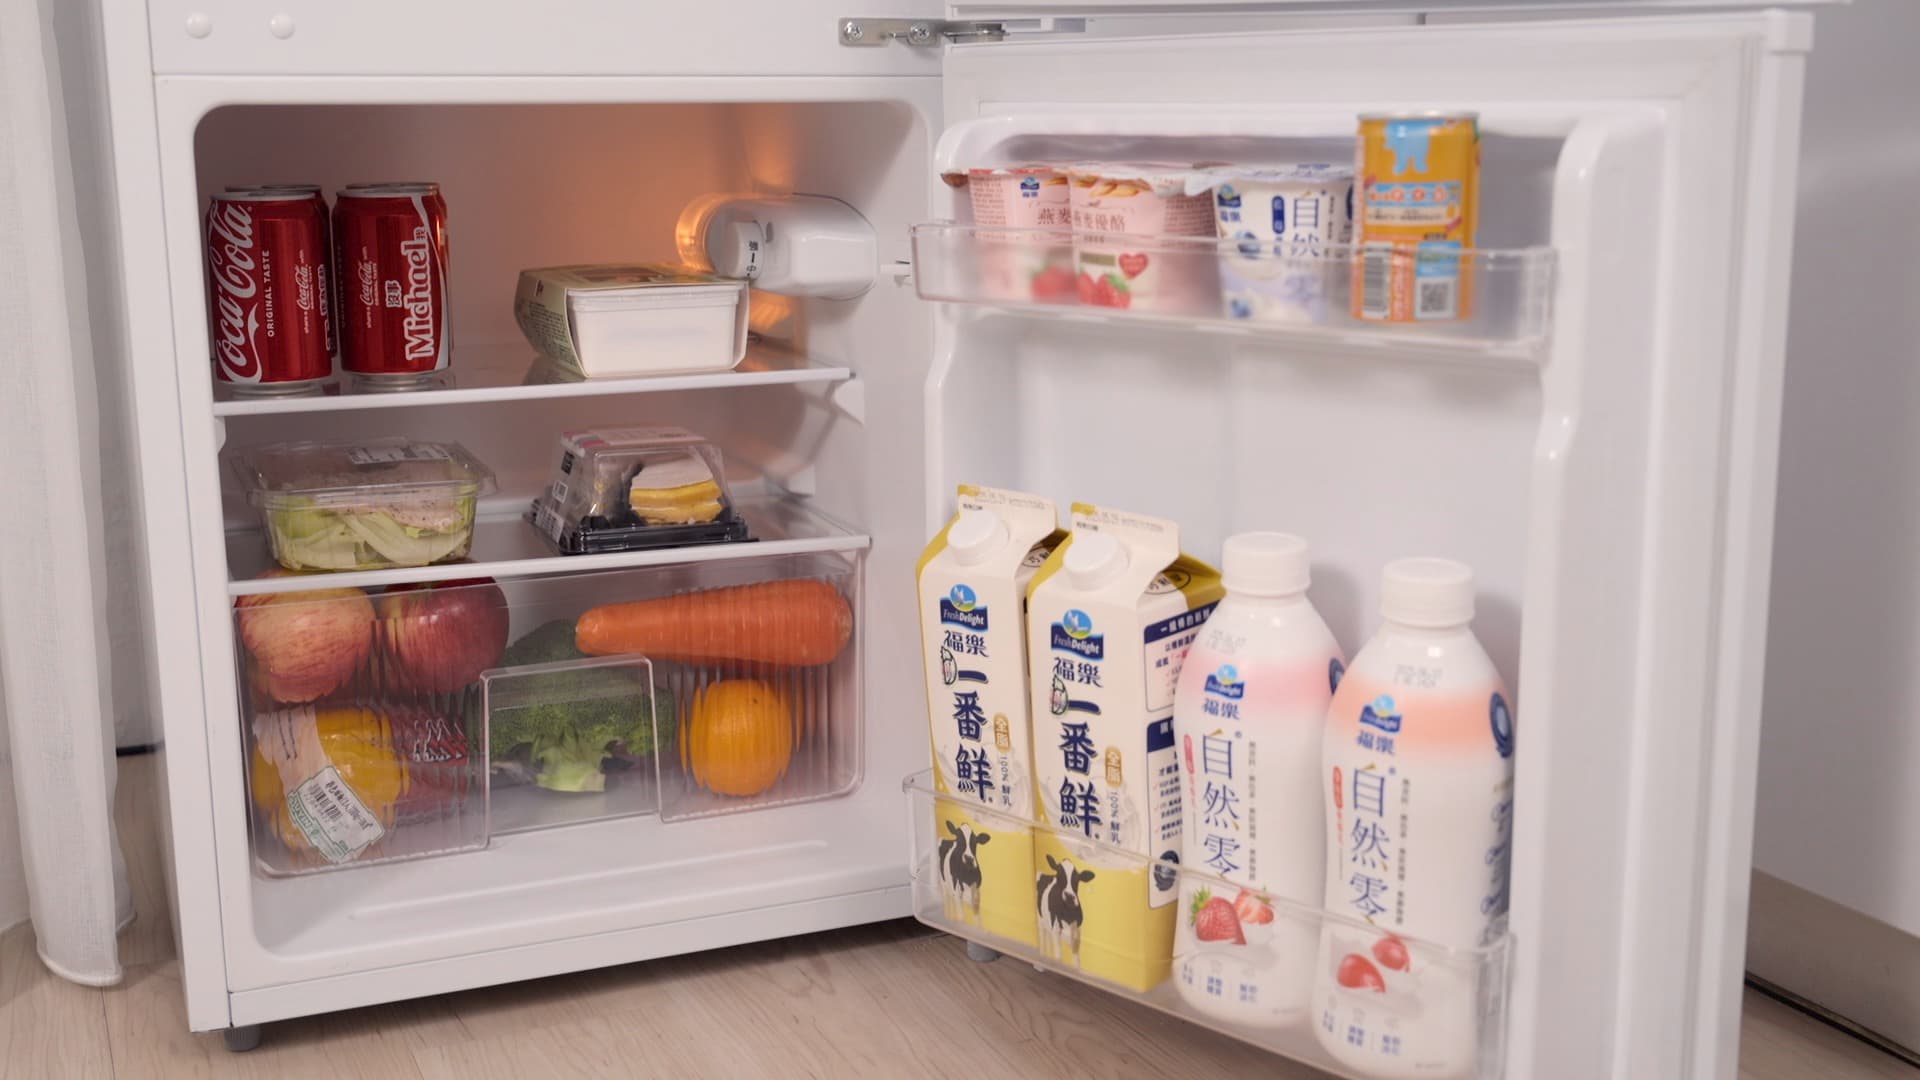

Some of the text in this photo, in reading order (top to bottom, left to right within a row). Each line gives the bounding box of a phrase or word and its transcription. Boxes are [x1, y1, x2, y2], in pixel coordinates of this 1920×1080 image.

[262, 251, 274, 337] ORIGINAL TASTE
[400, 241, 434, 361] Michael
[943, 630, 991, 658] 福樂
[1053, 657, 1105, 689] 福樂
[953, 670, 995, 803] 一番鮮
[1059, 700, 1103, 837] 一番鮮
[1202, 729, 1240, 879] 自然零
